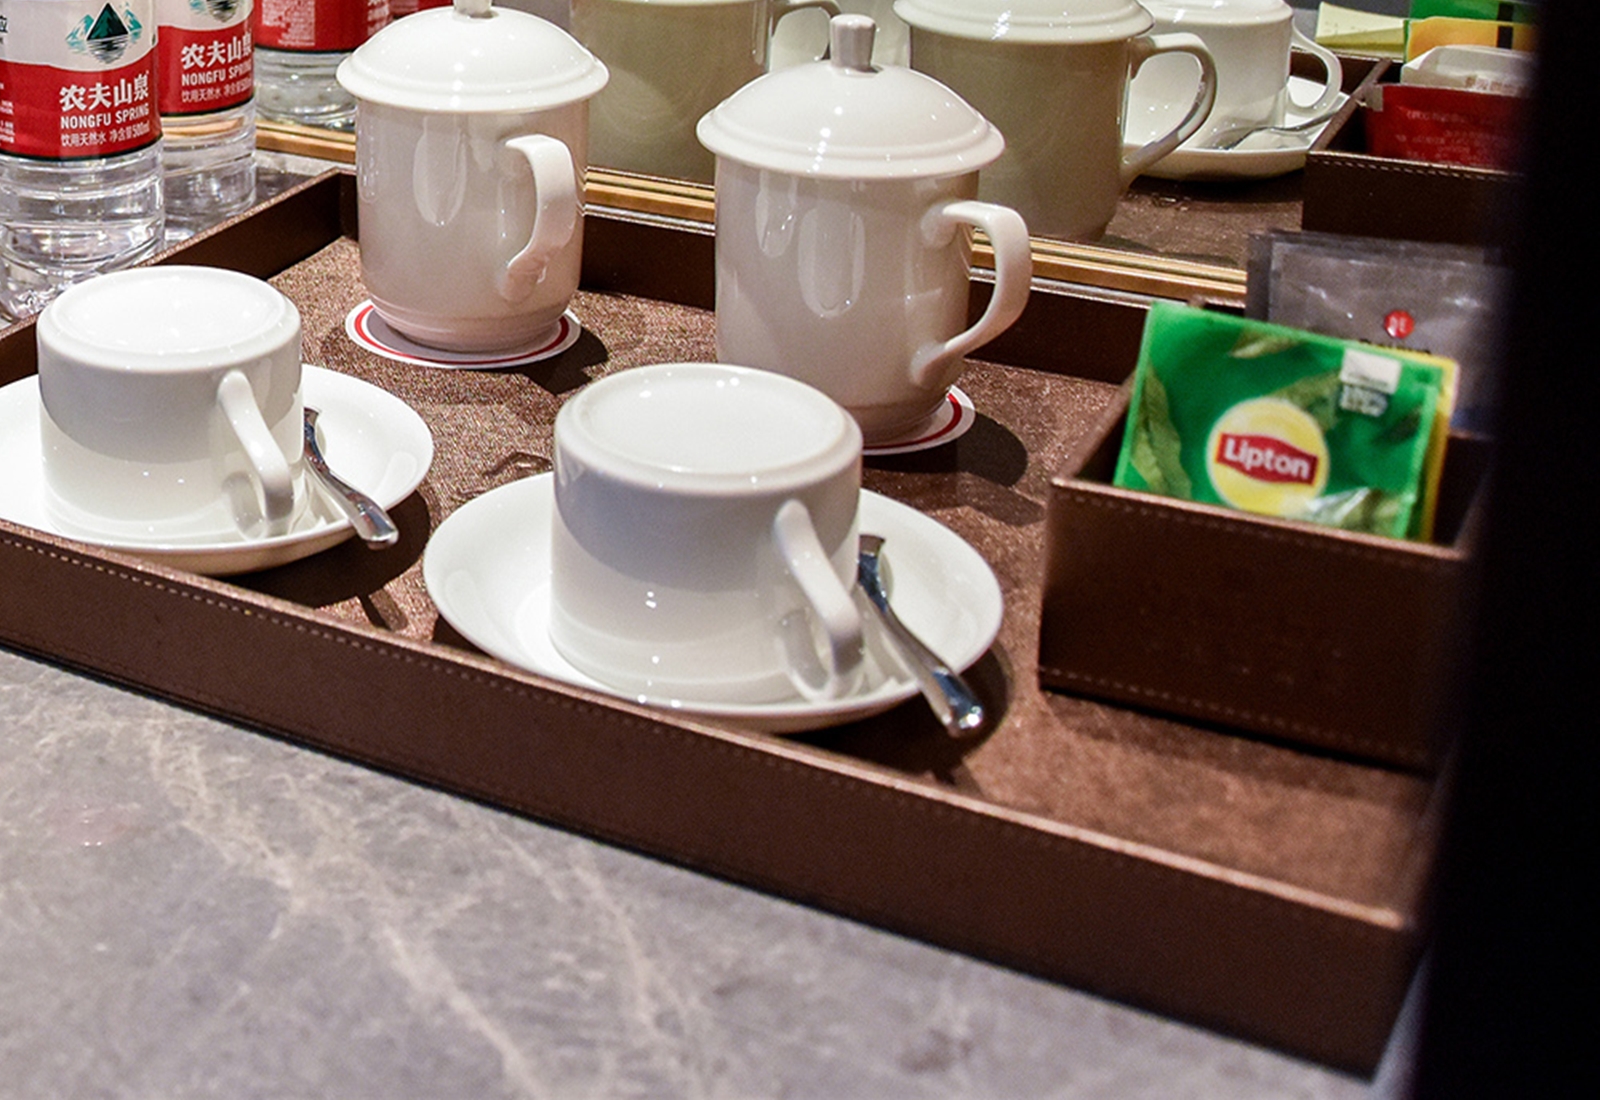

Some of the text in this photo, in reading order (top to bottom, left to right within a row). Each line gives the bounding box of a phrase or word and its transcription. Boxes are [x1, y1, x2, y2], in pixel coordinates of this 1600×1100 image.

[181, 69, 227, 87] NONGFU
[59, 73, 149, 112] 农夫山泉
[60, 103, 150, 130] NONGFU SPRING
[60, 131, 107, 148] 饮用天然水
[1223, 437, 1311, 481] Lipton
